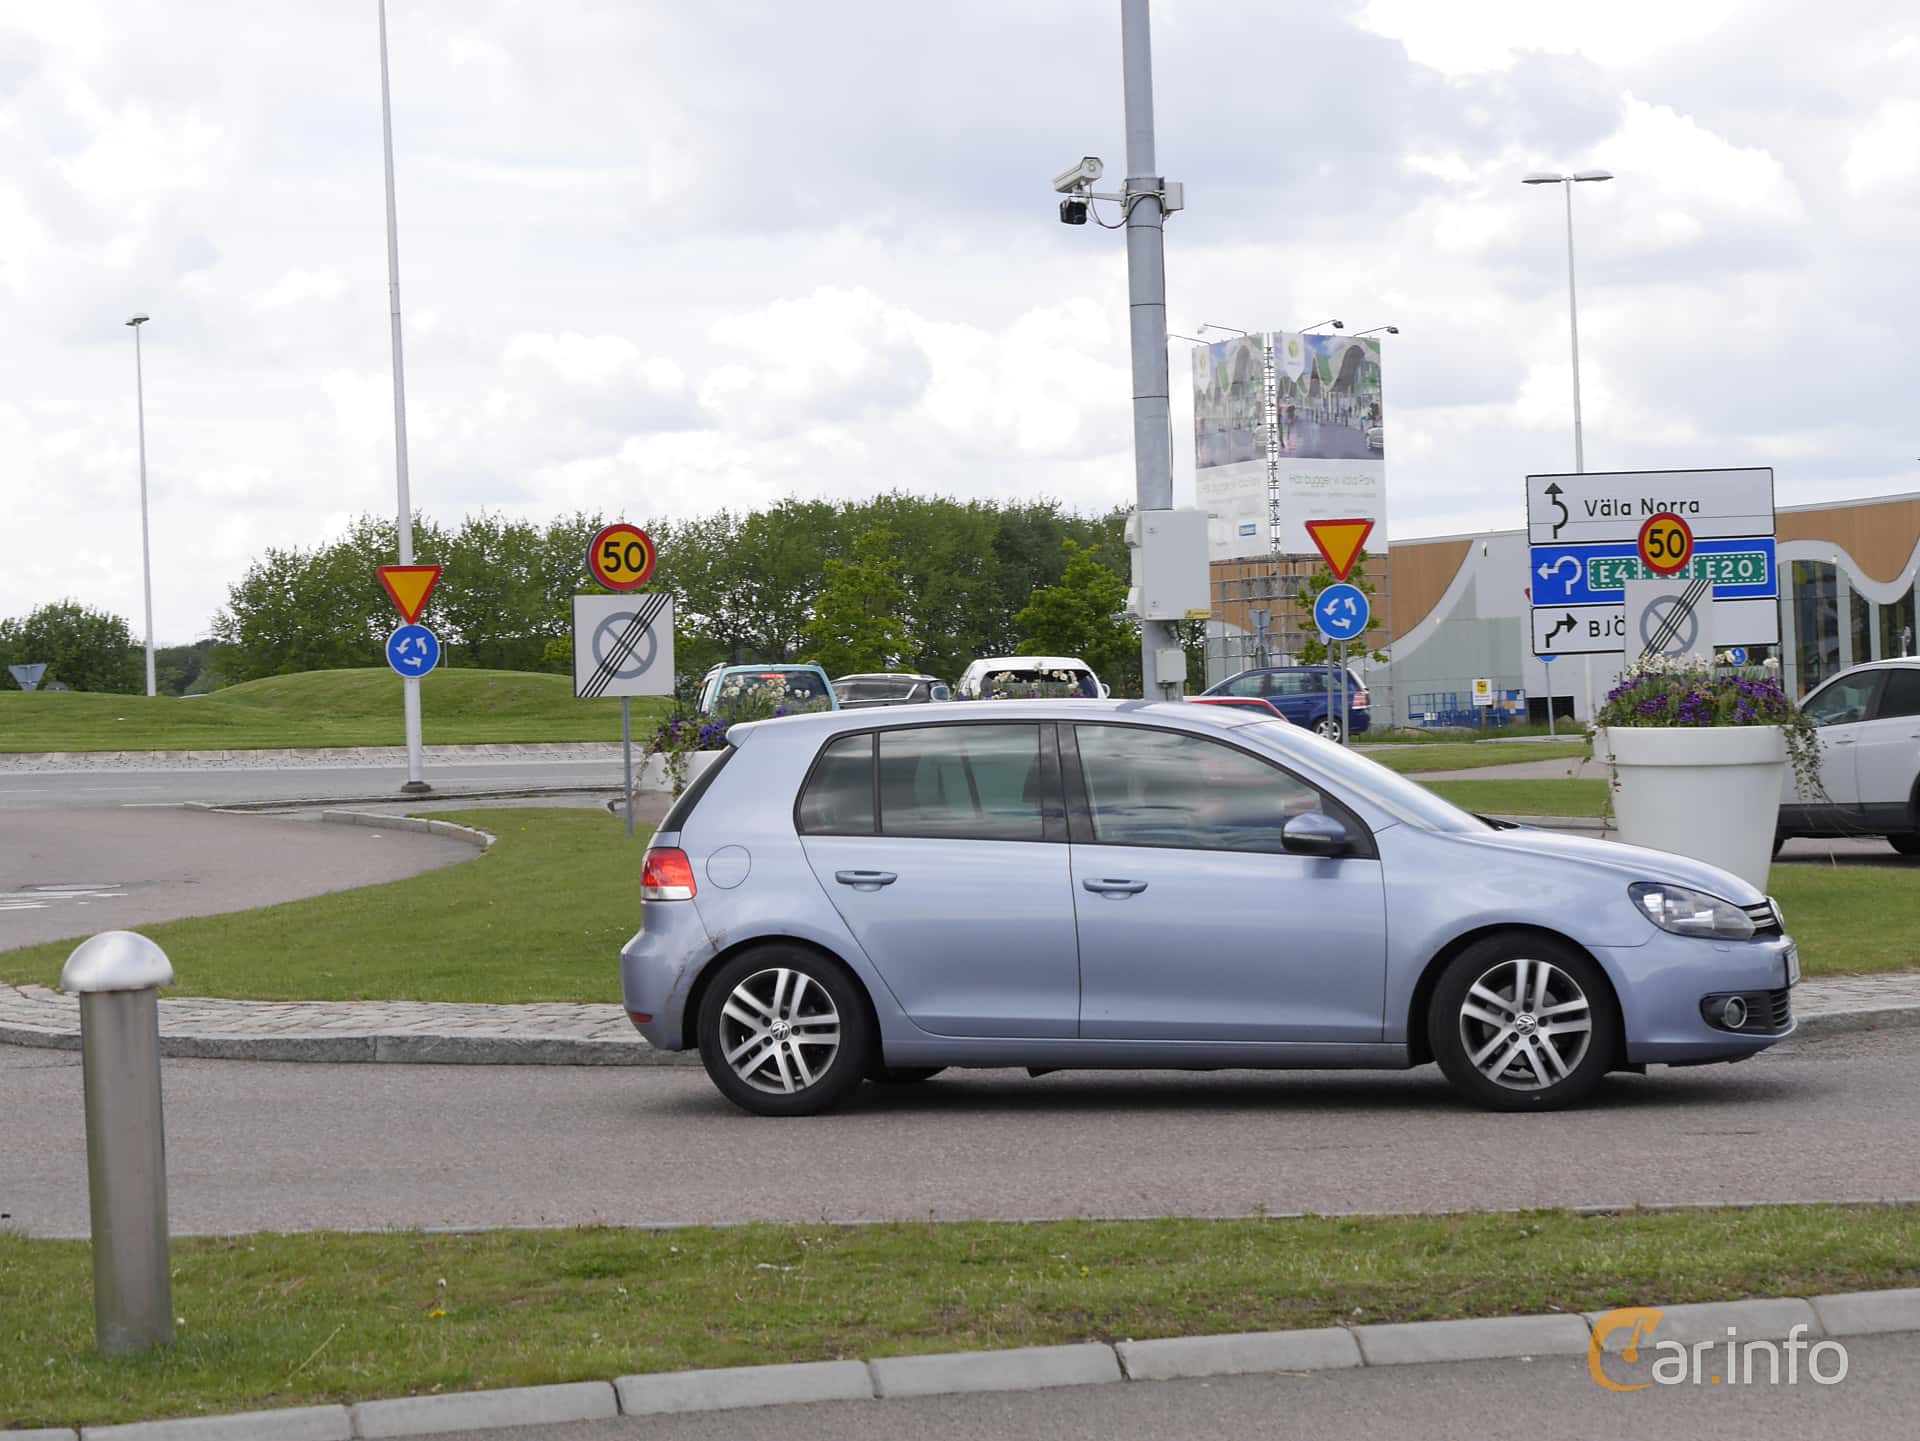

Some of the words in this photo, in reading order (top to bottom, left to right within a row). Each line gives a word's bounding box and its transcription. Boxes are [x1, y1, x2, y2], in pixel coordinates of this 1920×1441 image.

[1584, 498, 1632, 517] Väla
[1640, 497, 1700, 515] Norra
[1649, 528, 1685, 558] 50
[603, 541, 646, 573] 50
[1600, 565, 1628, 583] E4
[1705, 559, 1753, 579] E20
